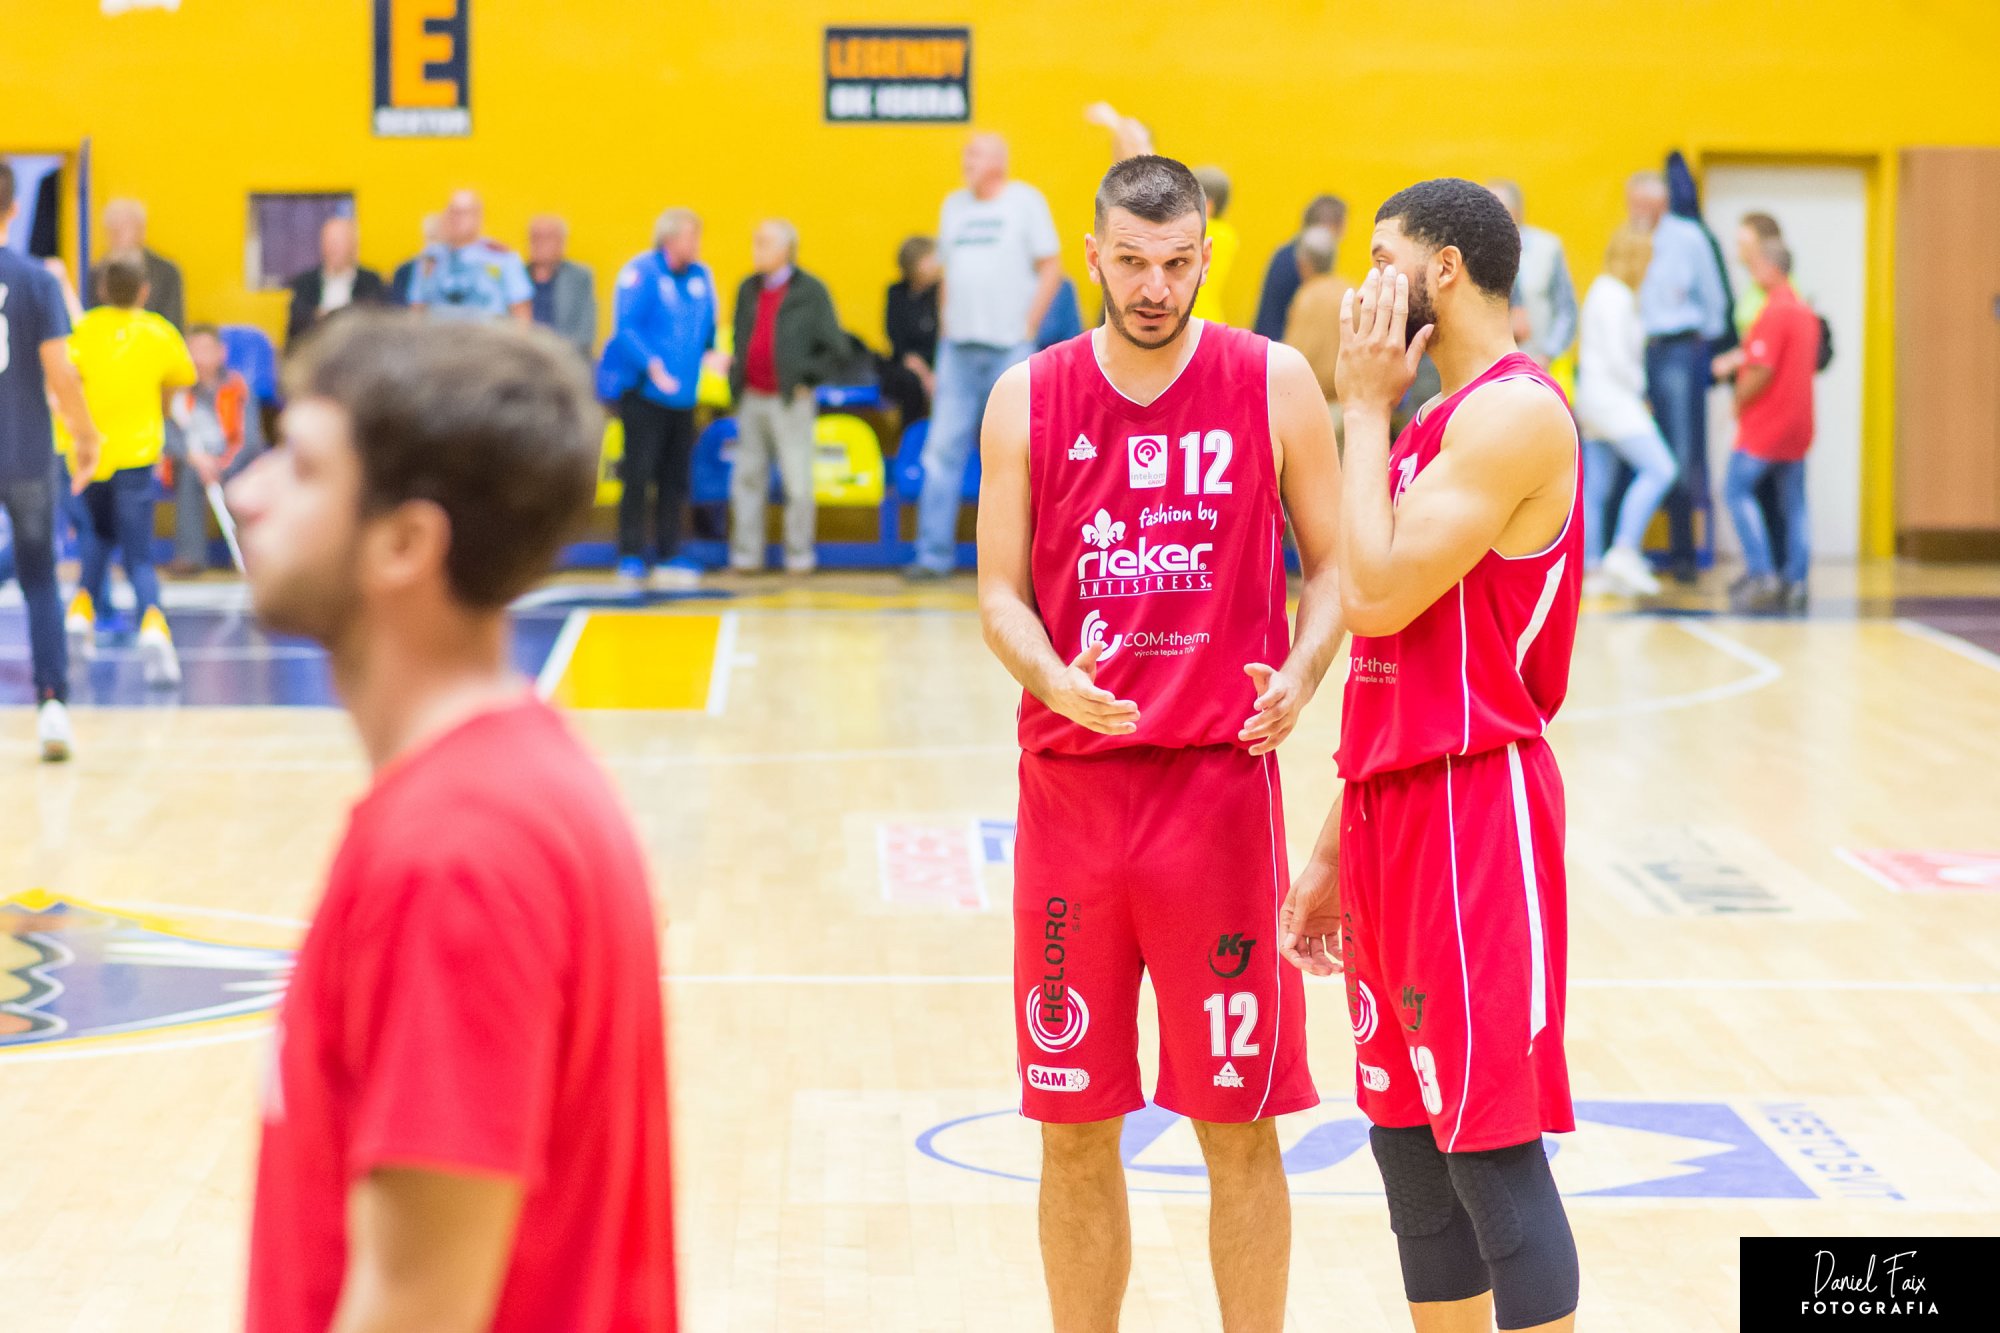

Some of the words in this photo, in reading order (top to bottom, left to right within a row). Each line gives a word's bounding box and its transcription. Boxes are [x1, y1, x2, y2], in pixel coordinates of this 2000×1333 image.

[1068, 446, 1098, 461] PEAK
[1179, 429, 1233, 496] 12
[1131, 471, 1166, 480] intekom
[1139, 503, 1192, 529] fashion
[1198, 501, 1218, 530] by
[1078, 537, 1213, 580] rieker
[1123, 631, 1210, 647] COM-therm
[1135, 648, 1158, 658] výroba
[1160, 648, 1178, 657] tepla
[1043, 897, 1067, 1022] HELORO
[1203, 991, 1260, 1057] 12
[1031, 1068, 1067, 1087] SAM
[1213, 1074, 1244, 1088] PEAK
